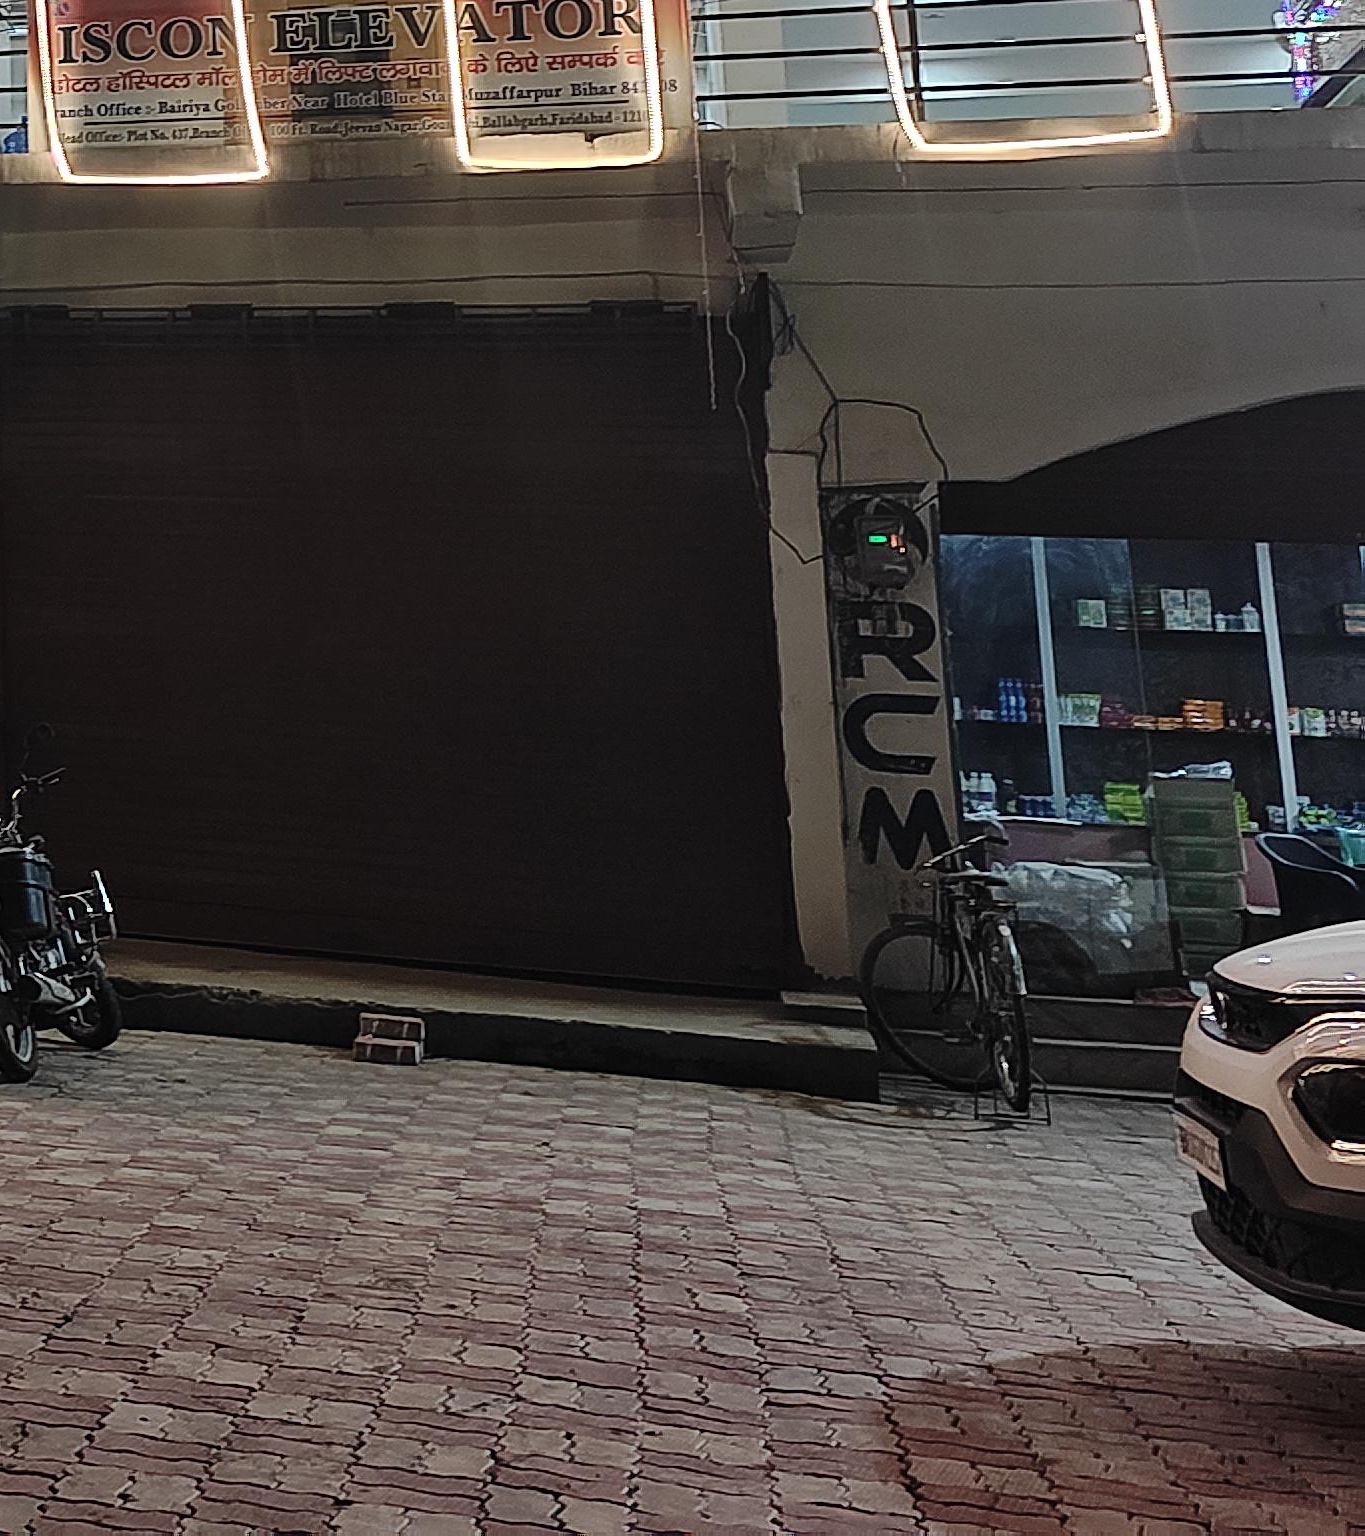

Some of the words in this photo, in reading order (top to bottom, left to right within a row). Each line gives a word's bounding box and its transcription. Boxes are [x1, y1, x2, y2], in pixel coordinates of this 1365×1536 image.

[56, 15, 254, 65] ISCON
[51, 104, 94, 119] ranch
[96, 102, 143, 117] Office
[158, 98, 211, 118] Bairiya
[214, 97, 287, 114] Golber
[290, 94, 328, 110] Near
[334, 91, 380, 109] Hotel
[382, 90, 418, 107] Blue
[419, 88, 449, 104] Sta
[570, 80, 618, 98] Bihar
[620, 78, 679, 96] 8408
